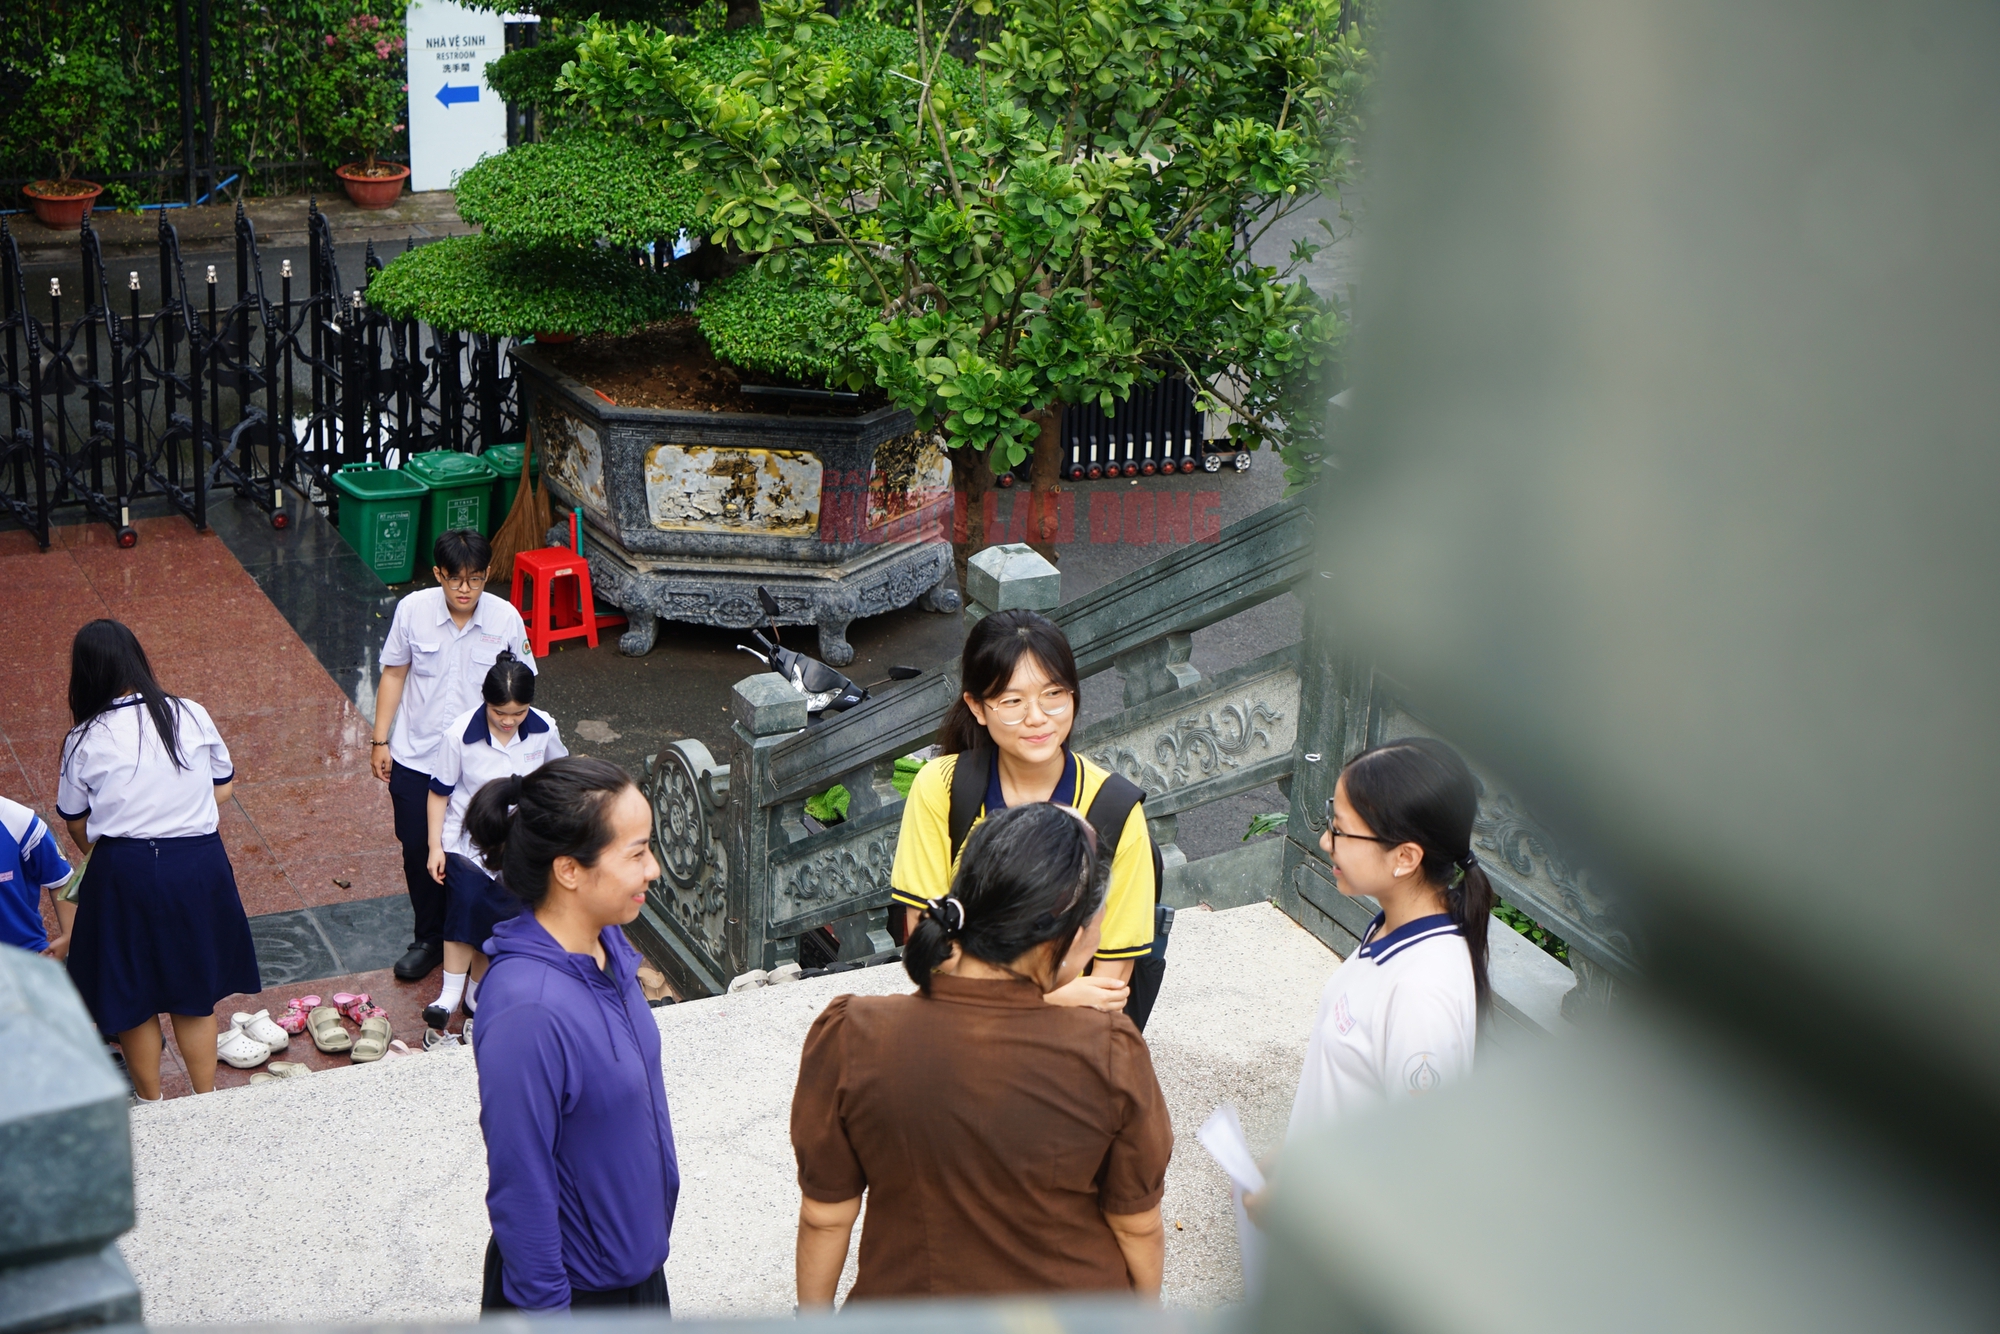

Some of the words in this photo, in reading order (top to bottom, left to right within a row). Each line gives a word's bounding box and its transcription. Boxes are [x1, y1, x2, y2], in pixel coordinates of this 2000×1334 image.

[426, 35, 447, 48] NHÀ
[448, 35, 460, 50] VỆ
[462, 36, 485, 46] SINH
[436, 51, 475, 60] RESTROOM
